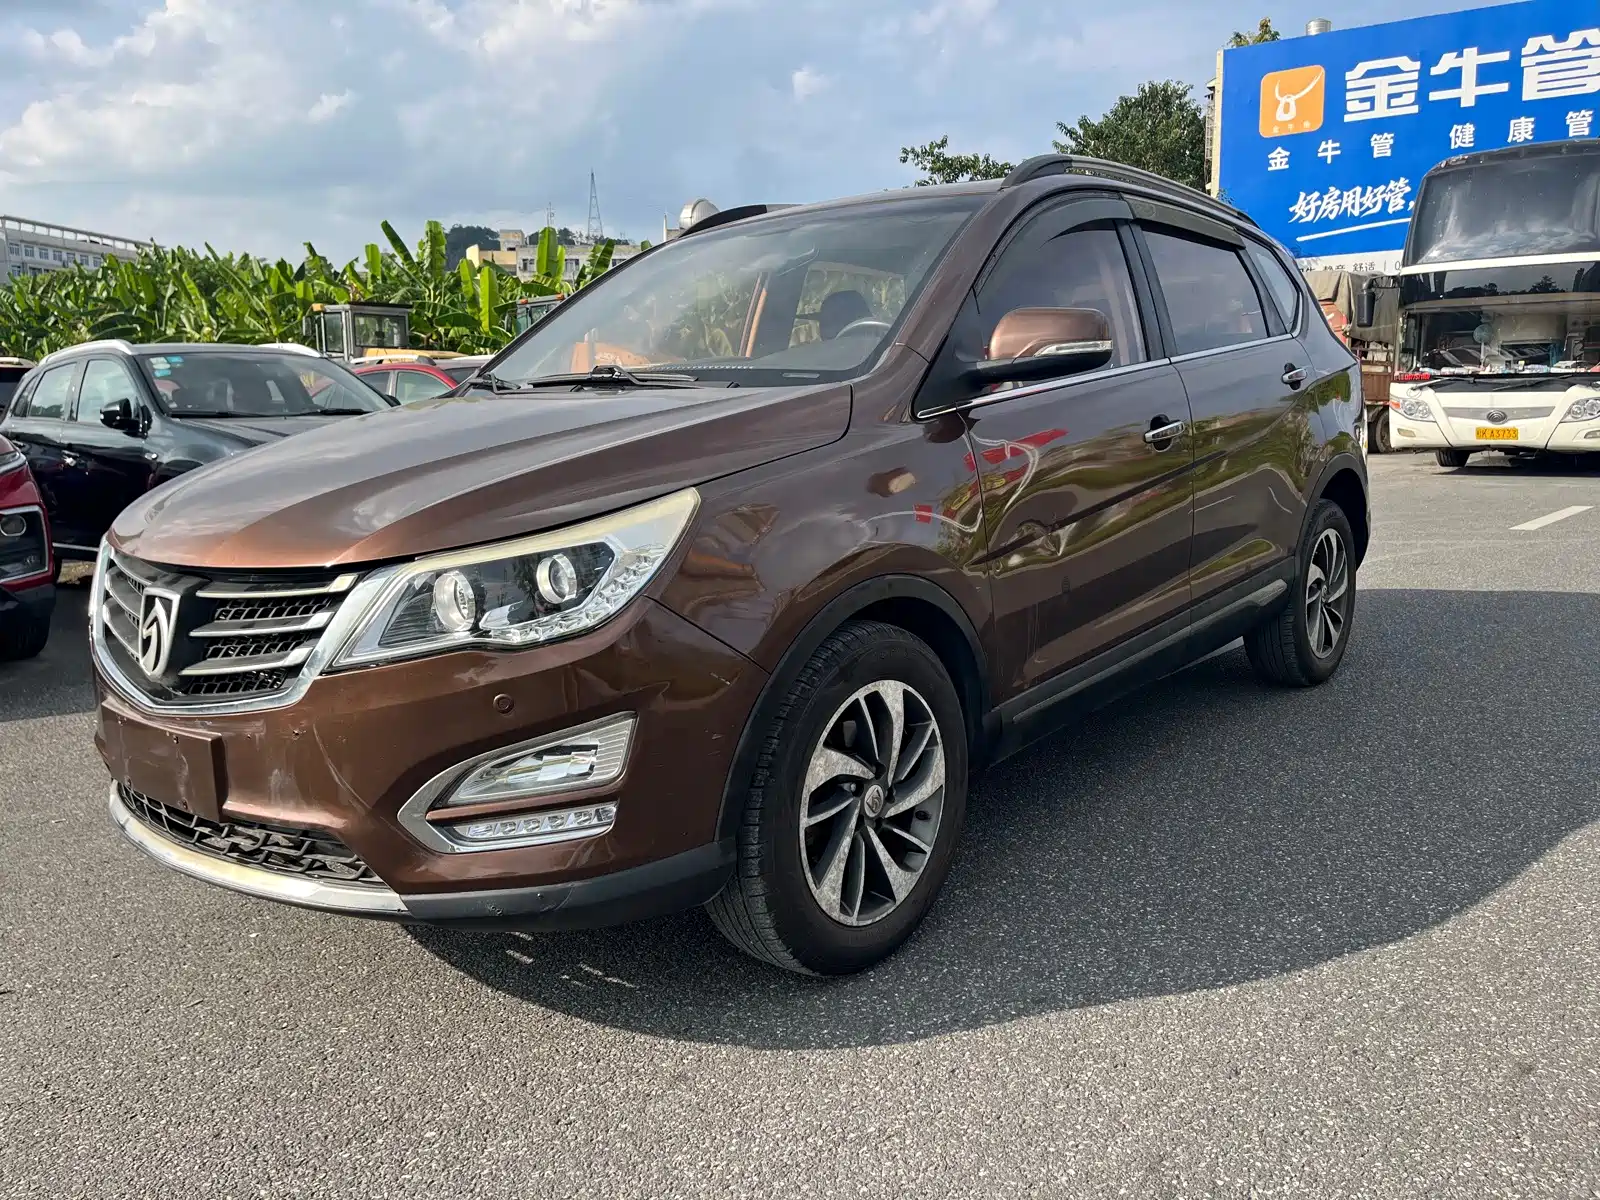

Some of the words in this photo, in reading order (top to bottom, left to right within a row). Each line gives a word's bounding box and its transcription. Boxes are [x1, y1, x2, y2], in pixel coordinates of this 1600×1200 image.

[1344, 28, 1600, 122] 金牛管
[1267, 132, 1395, 171] 金牛管
[1449, 109, 1593, 149] 健康管
